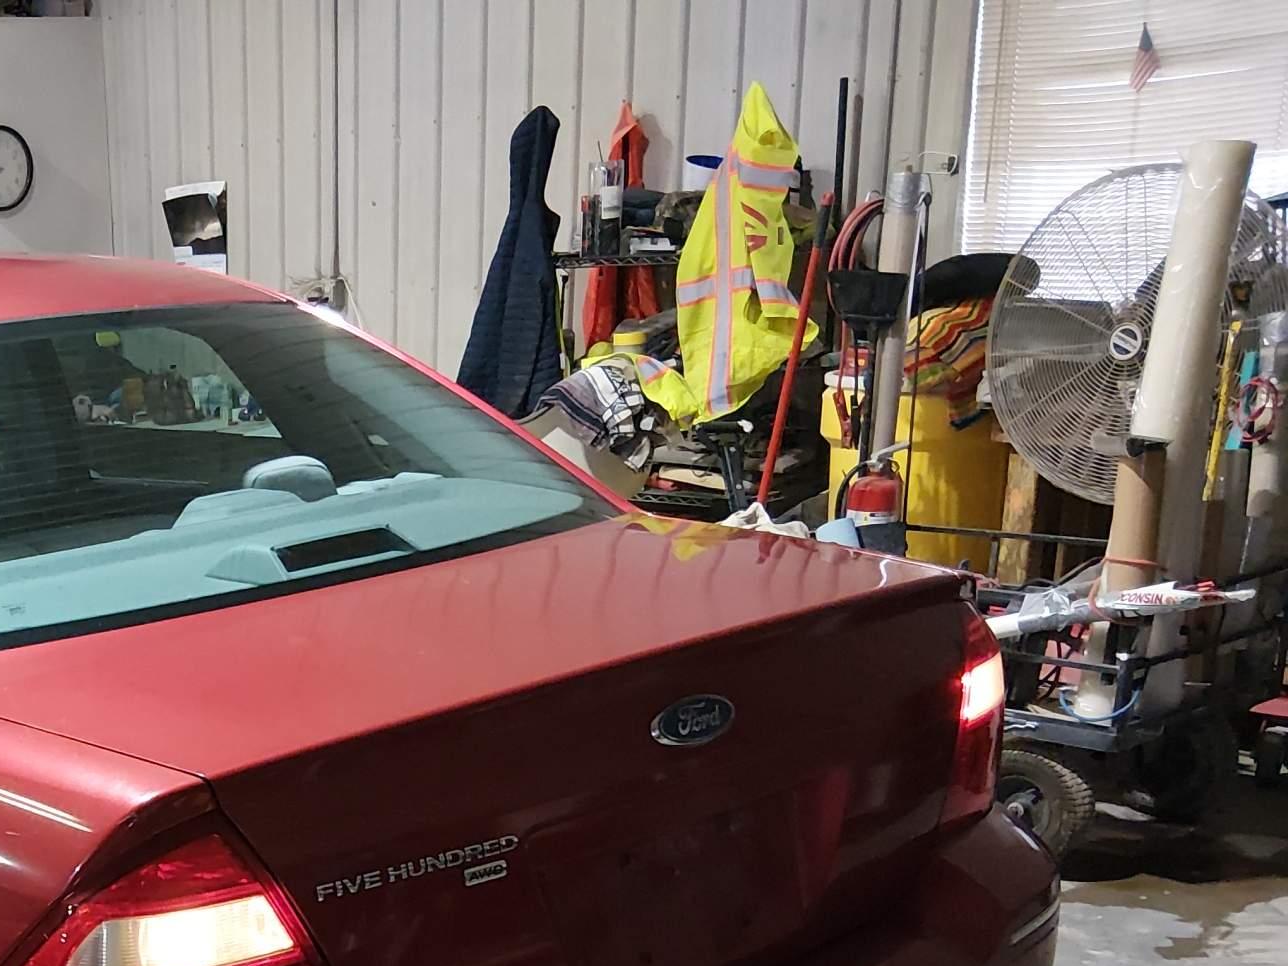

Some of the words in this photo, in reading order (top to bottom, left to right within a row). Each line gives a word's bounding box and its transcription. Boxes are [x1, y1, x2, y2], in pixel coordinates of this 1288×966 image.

[678, 701, 720, 736] Ford
[315, 870, 383, 902] FIVE
[387, 834, 519, 883] HUNDRED
[466, 862, 505, 883] AWD
